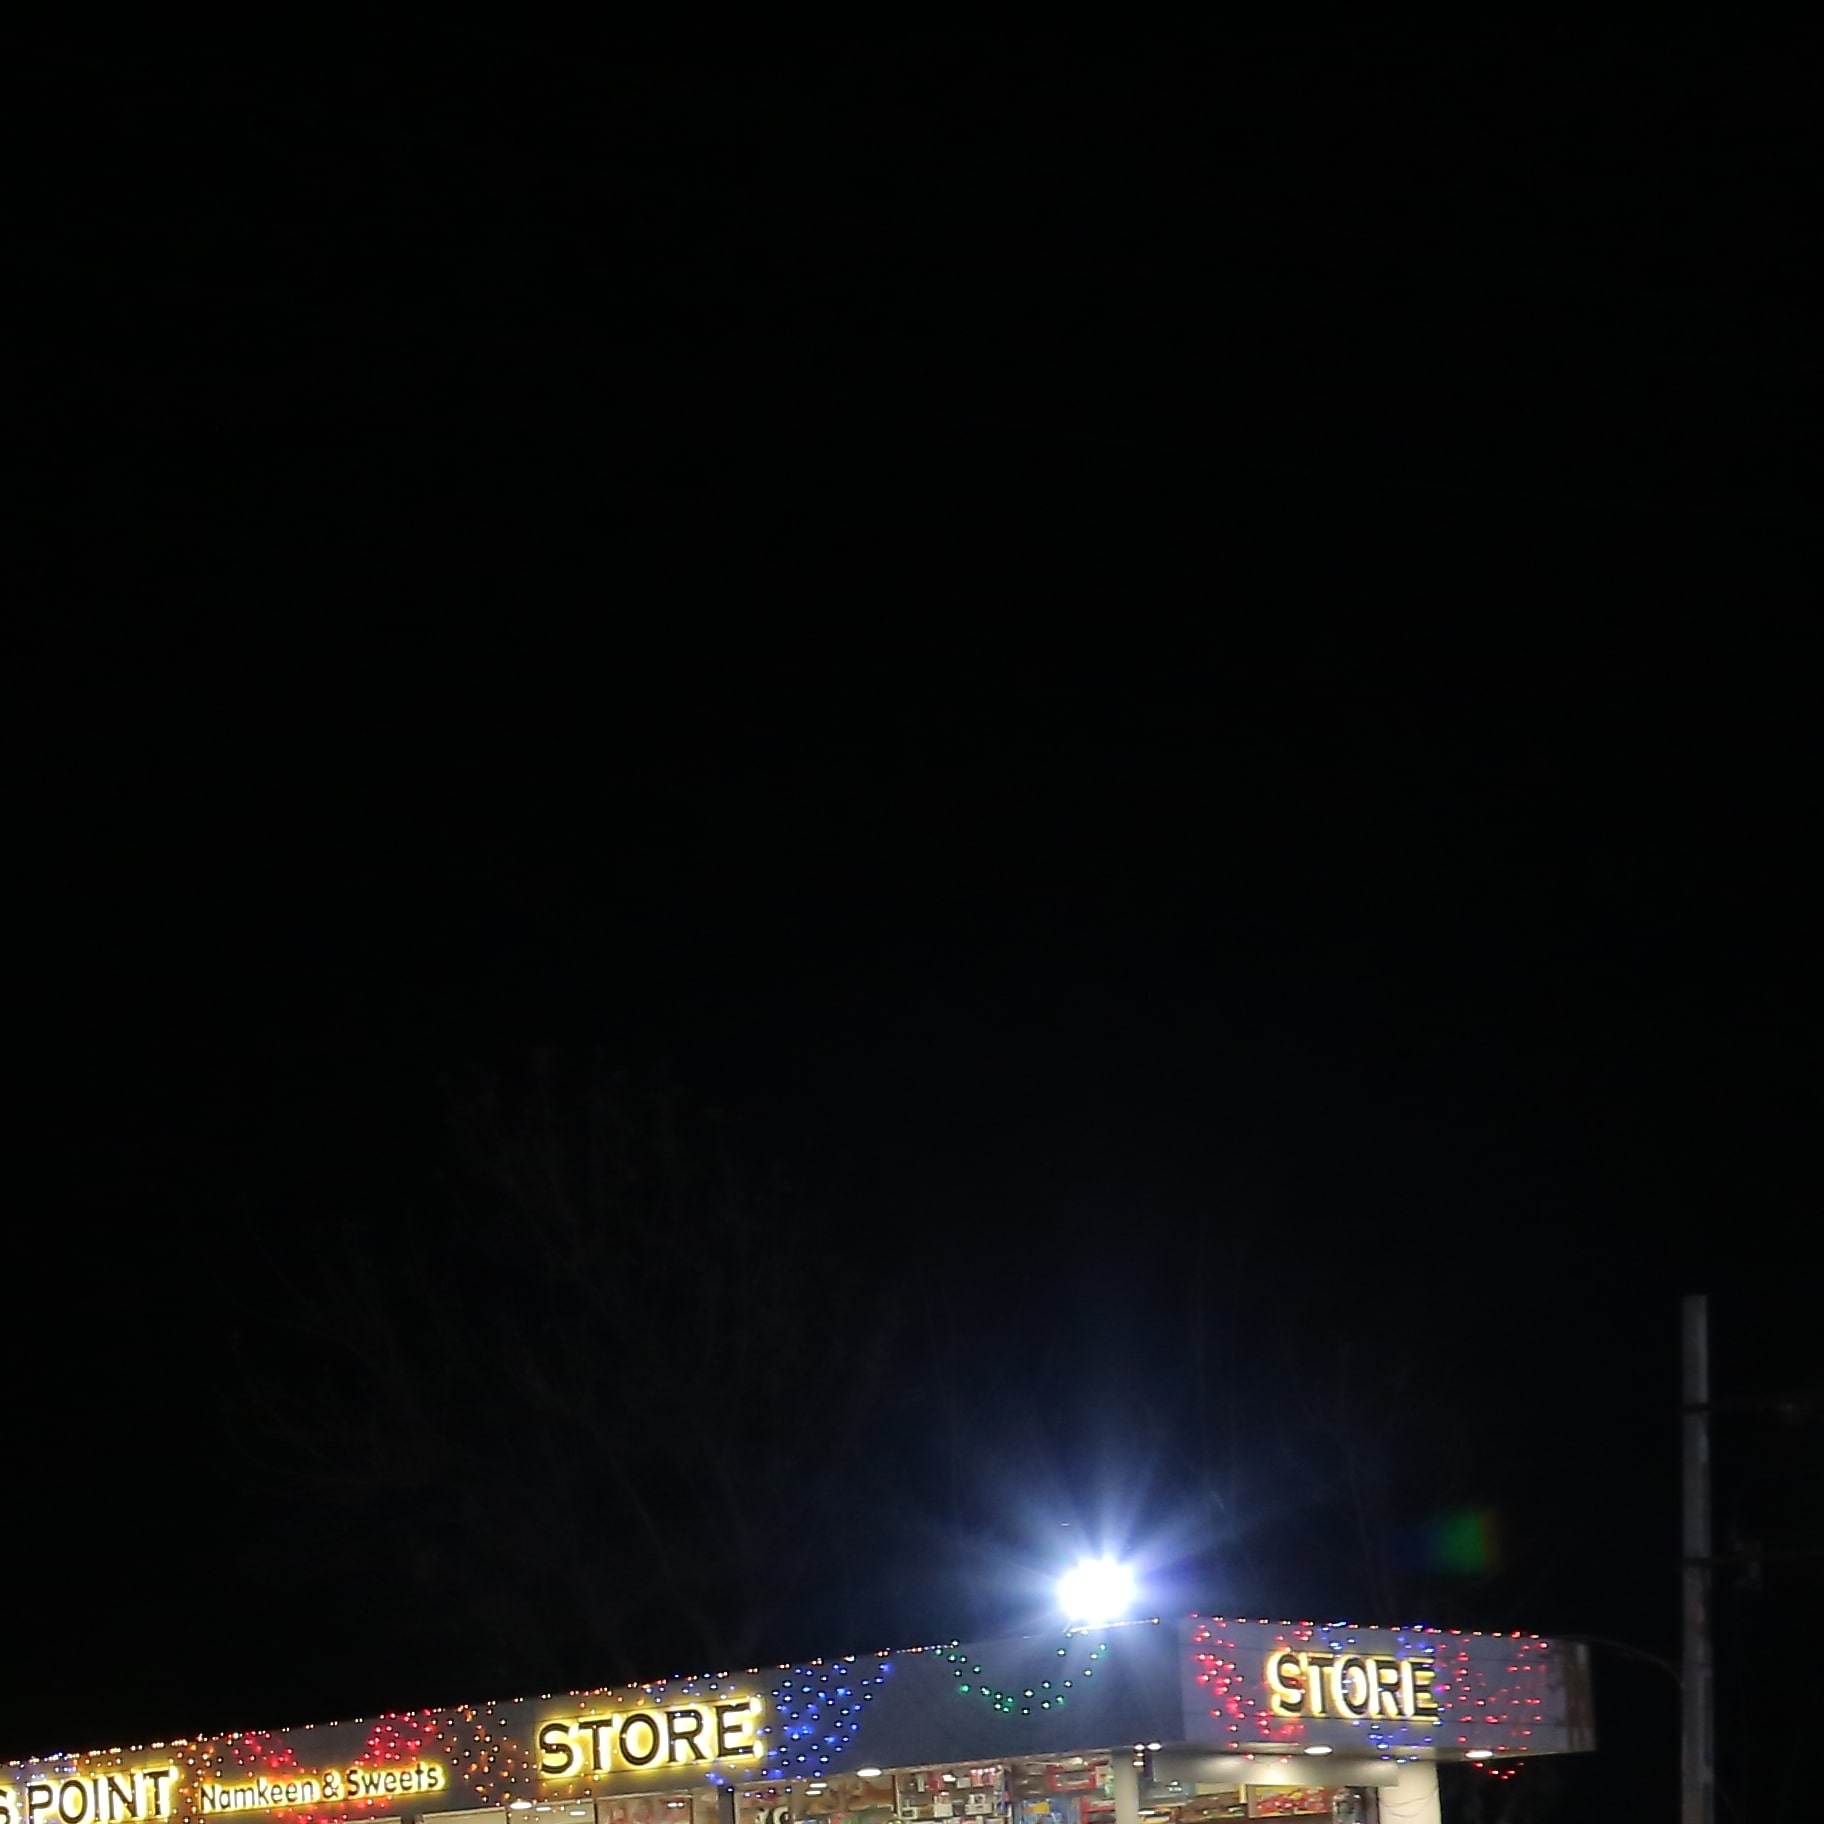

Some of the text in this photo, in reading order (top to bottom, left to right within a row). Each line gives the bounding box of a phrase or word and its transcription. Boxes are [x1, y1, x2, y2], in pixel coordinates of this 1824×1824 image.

[1266, 1649, 1442, 1722] STORE
[538, 1702, 755, 1775] STORE
[200, 1763, 440, 1811] Namkeen & Sweets
